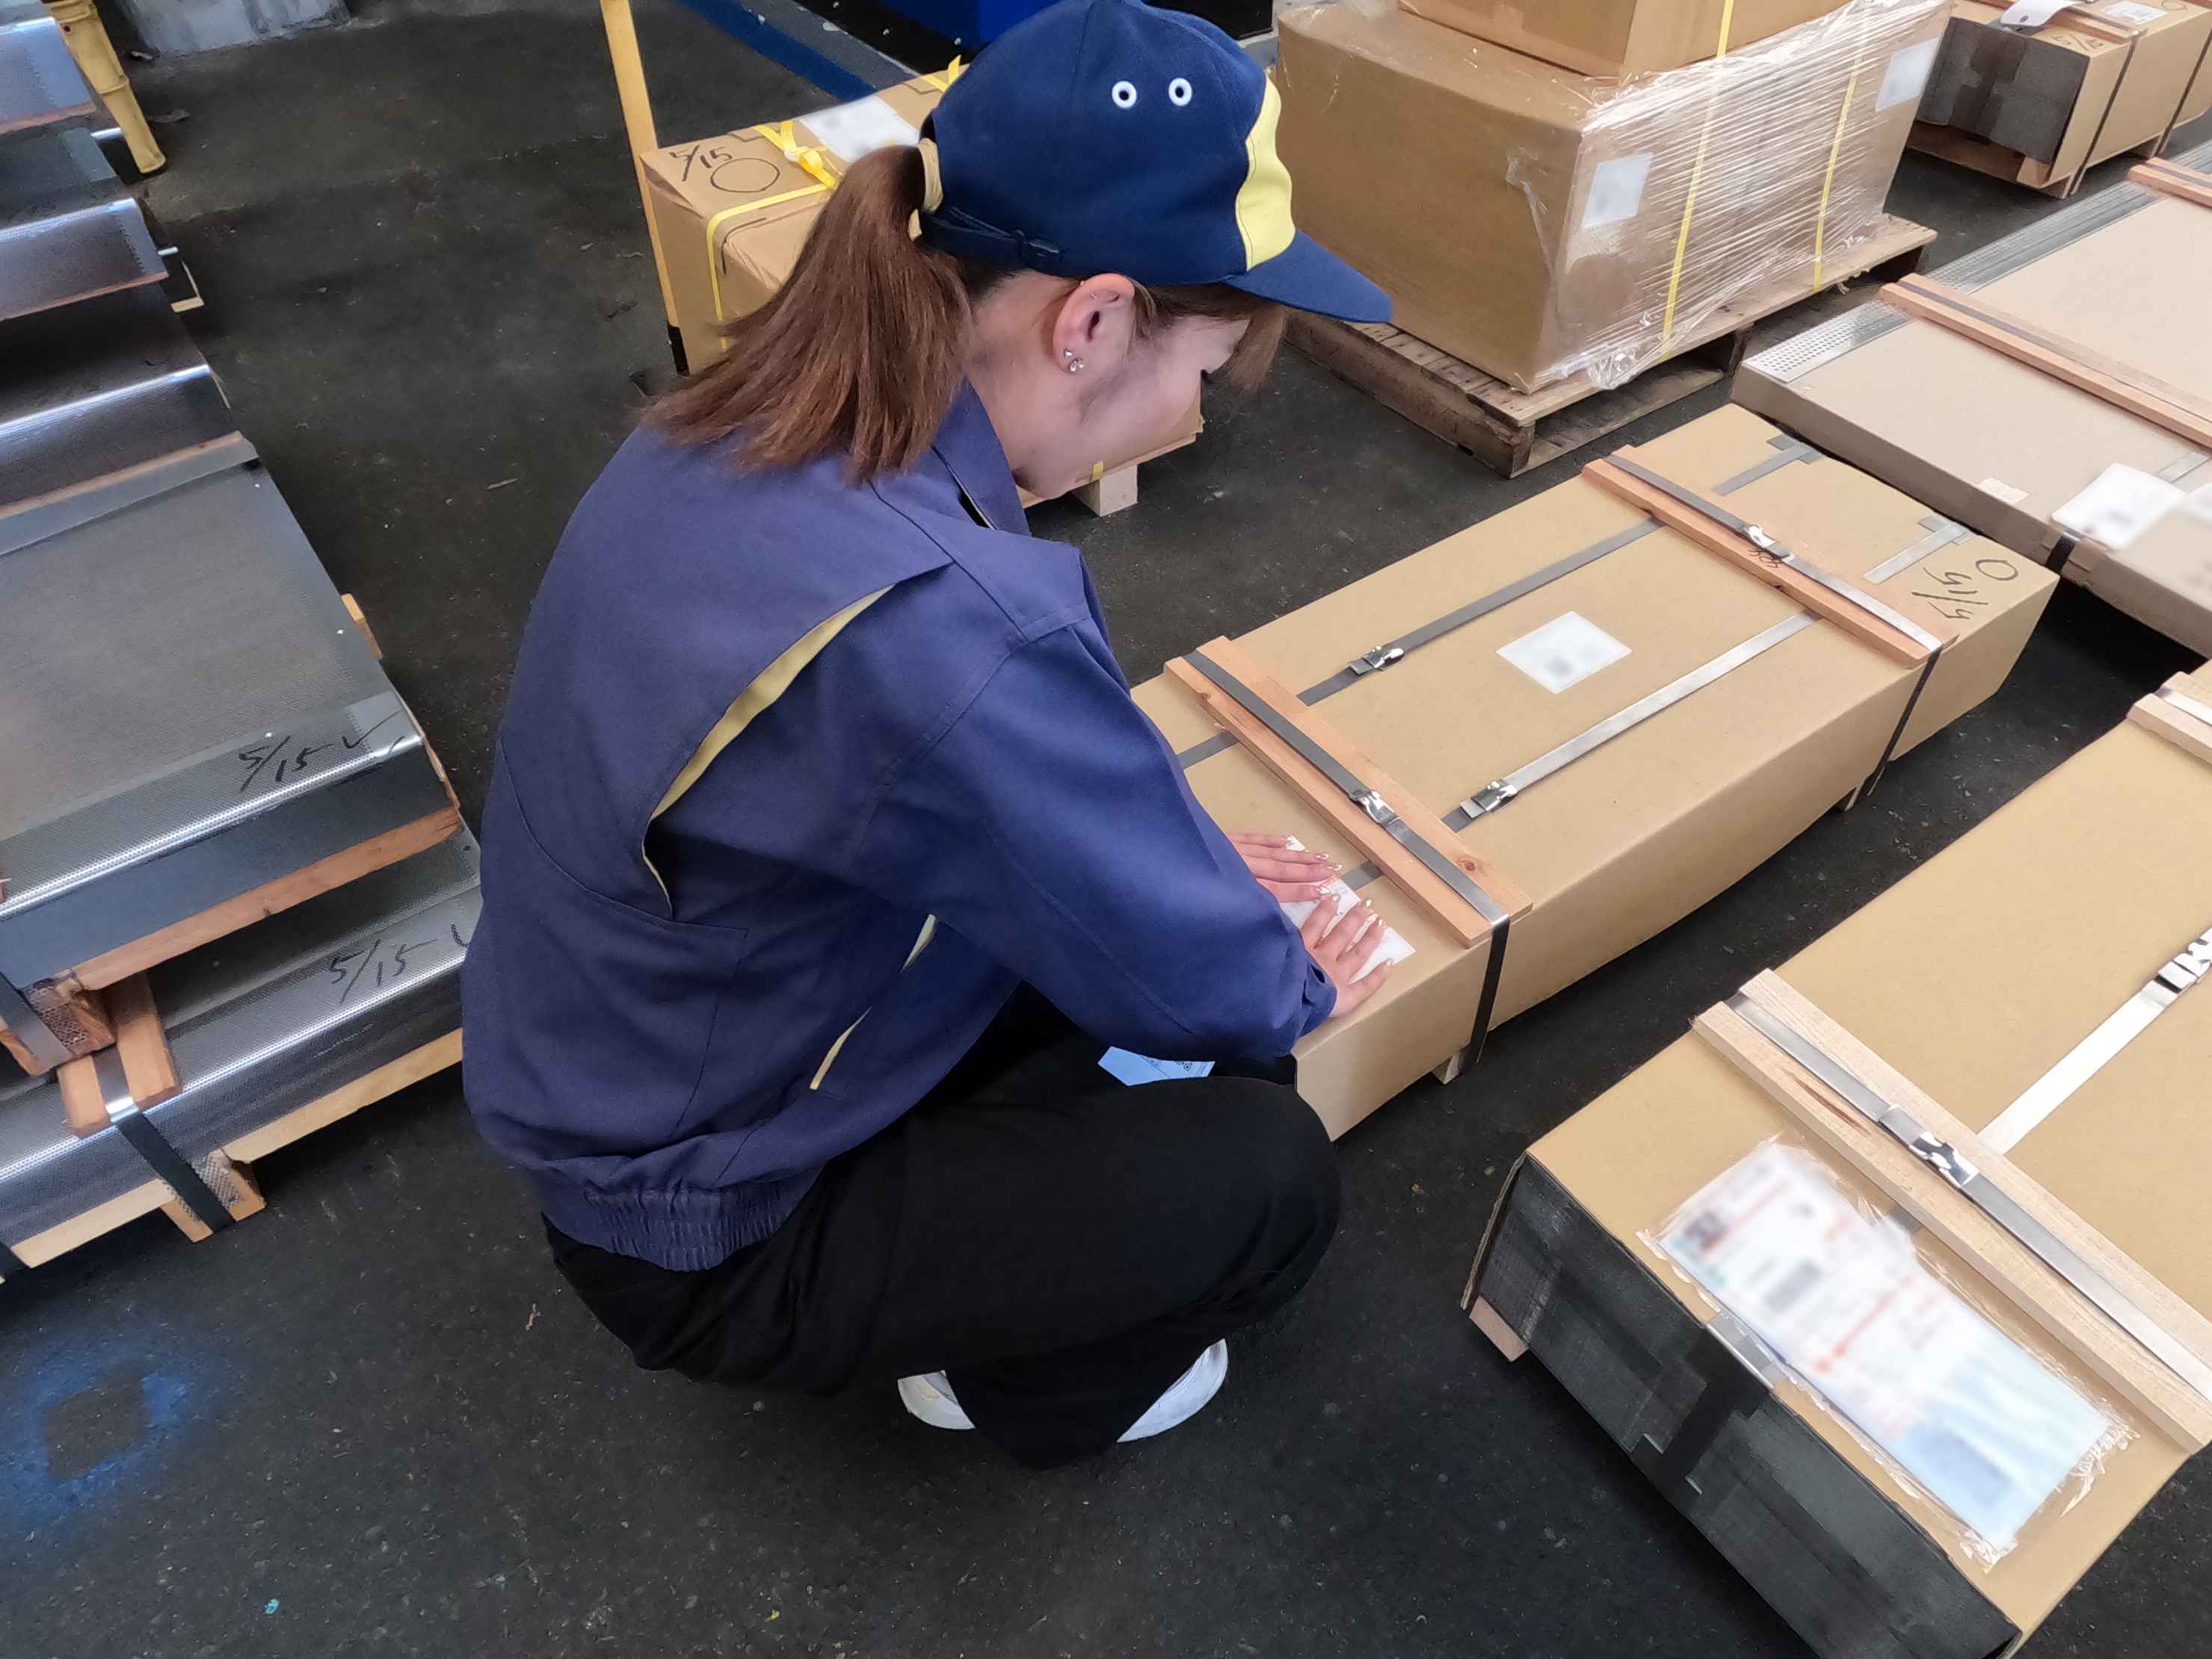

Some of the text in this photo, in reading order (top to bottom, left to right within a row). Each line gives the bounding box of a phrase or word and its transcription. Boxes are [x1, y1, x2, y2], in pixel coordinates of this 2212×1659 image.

[669, 144, 732, 182] 5/15
[1911, 566, 1989, 621] 5/15
[238, 735, 336, 792] 5/15
[330, 938, 438, 1005] 5/15
